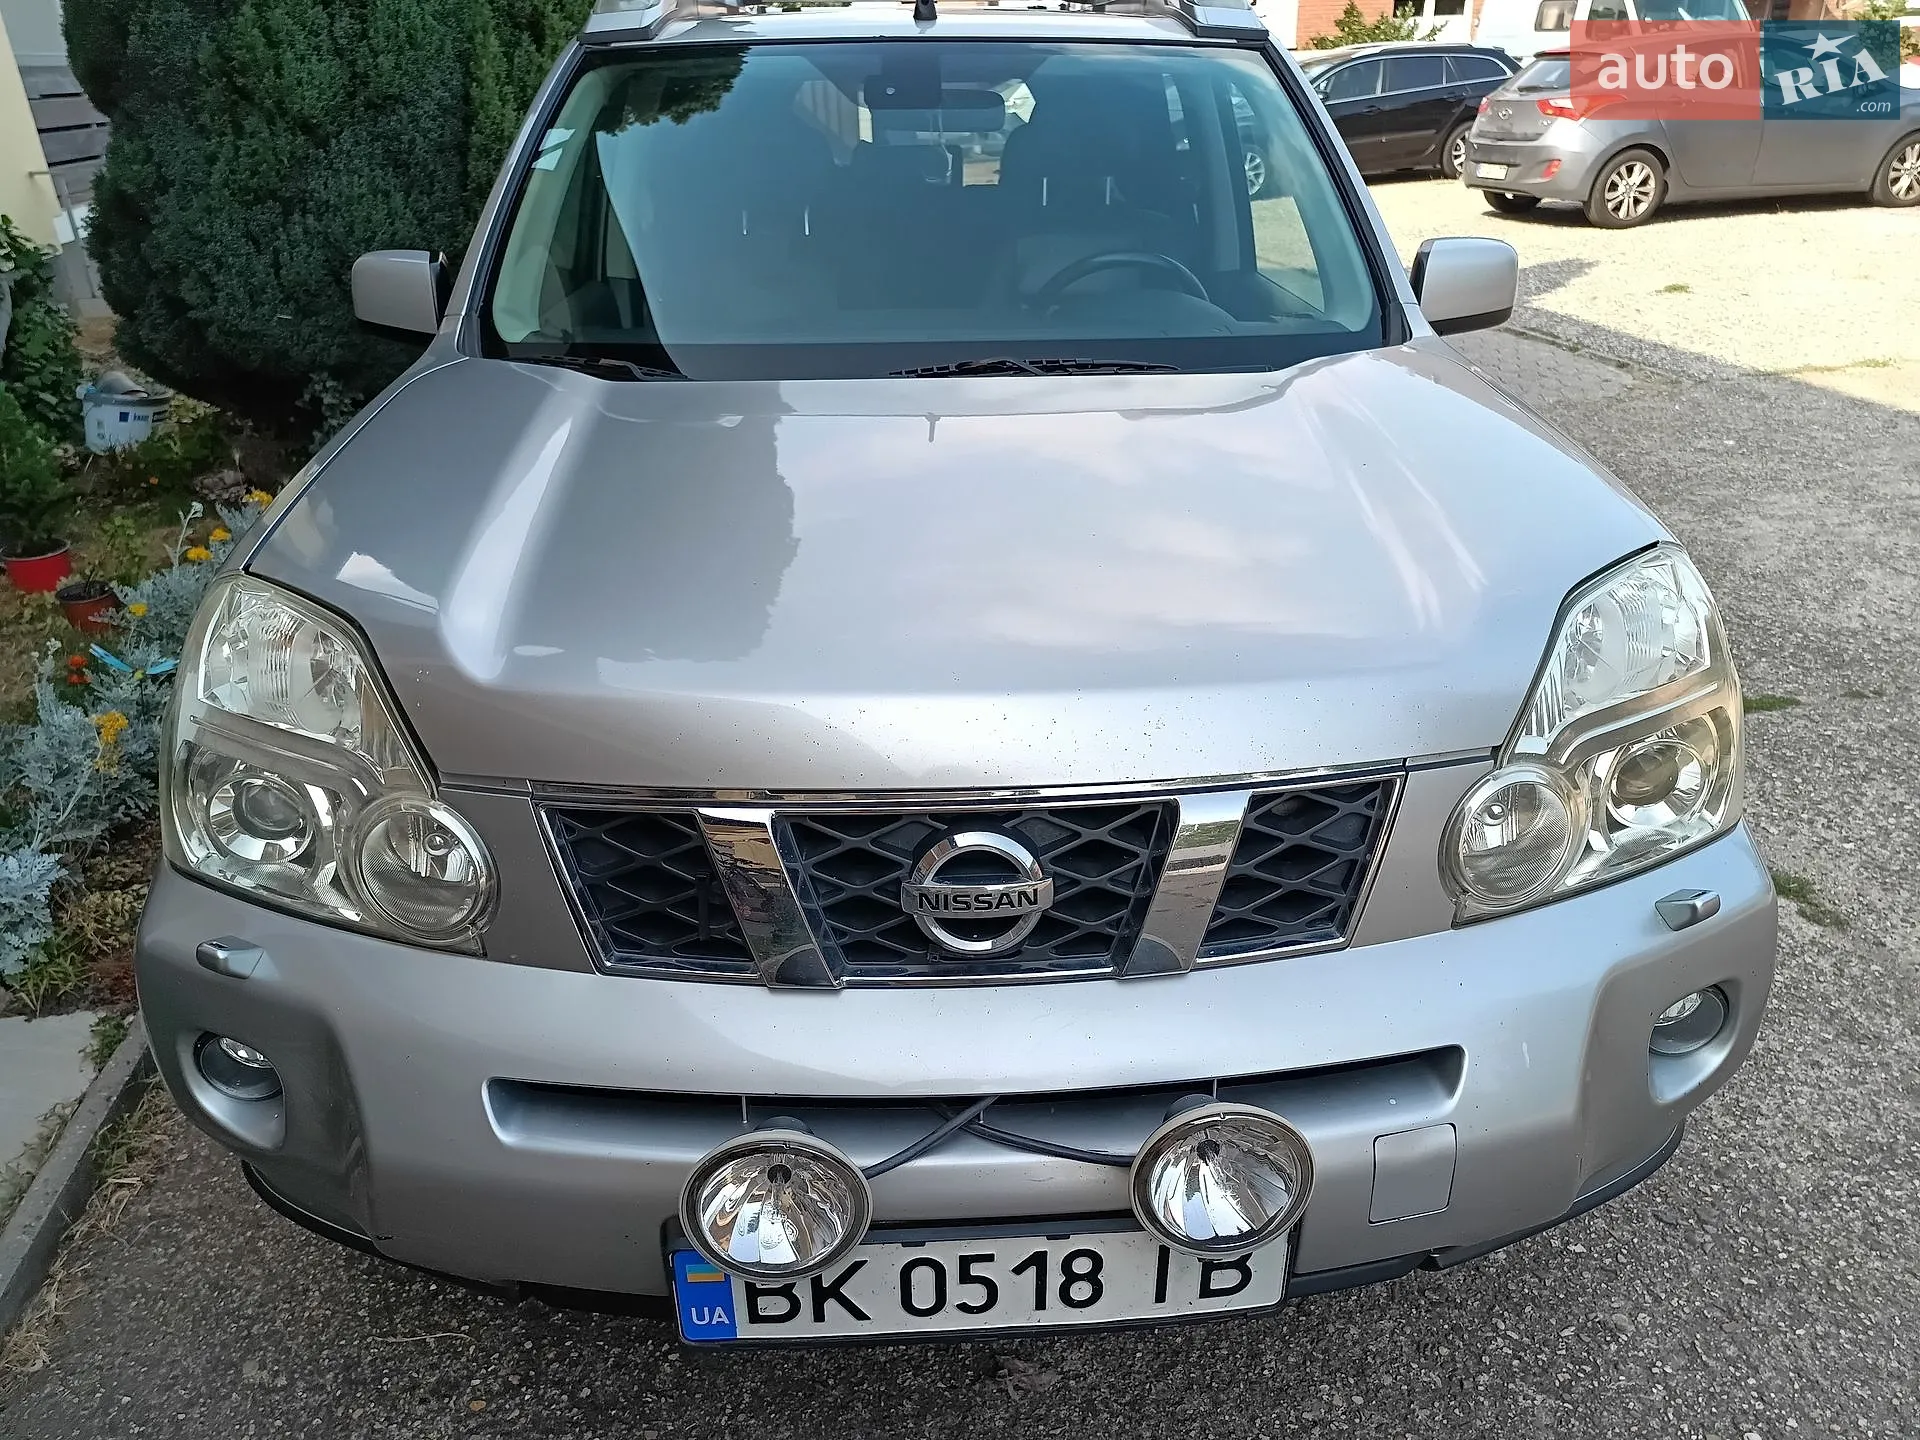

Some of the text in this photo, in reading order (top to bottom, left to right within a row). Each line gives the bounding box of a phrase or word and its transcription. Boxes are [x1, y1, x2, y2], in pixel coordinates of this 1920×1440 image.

[918, 888, 1038, 911] NISSAN
[745, 1259, 872, 1325] BK
[900, 1248, 1105, 1318] 0518
[691, 1306, 730, 1325] UA
